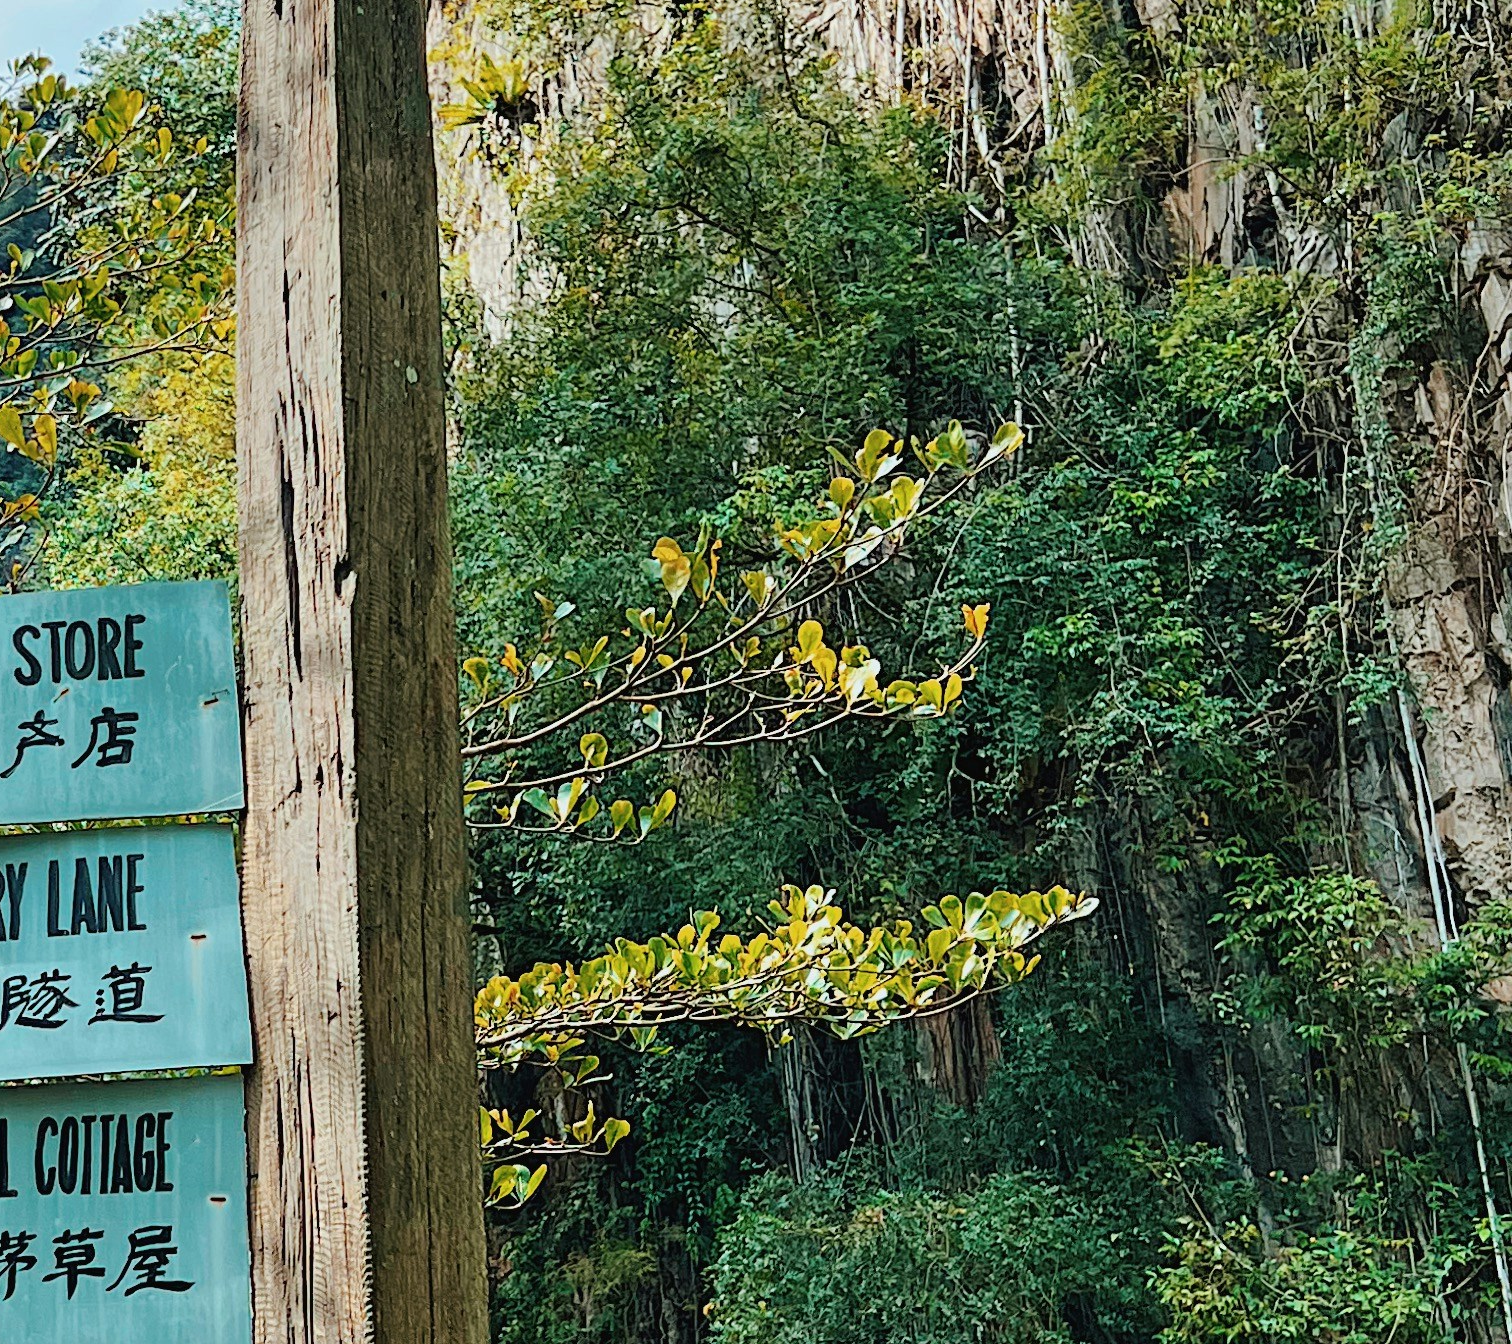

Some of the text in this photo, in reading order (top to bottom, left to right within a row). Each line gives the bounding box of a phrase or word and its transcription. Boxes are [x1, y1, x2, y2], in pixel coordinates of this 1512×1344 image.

[13, 614, 145, 686] STORE
[46, 853, 146, 937] LANE
[35, 1112, 174, 1196] COTTAGE
